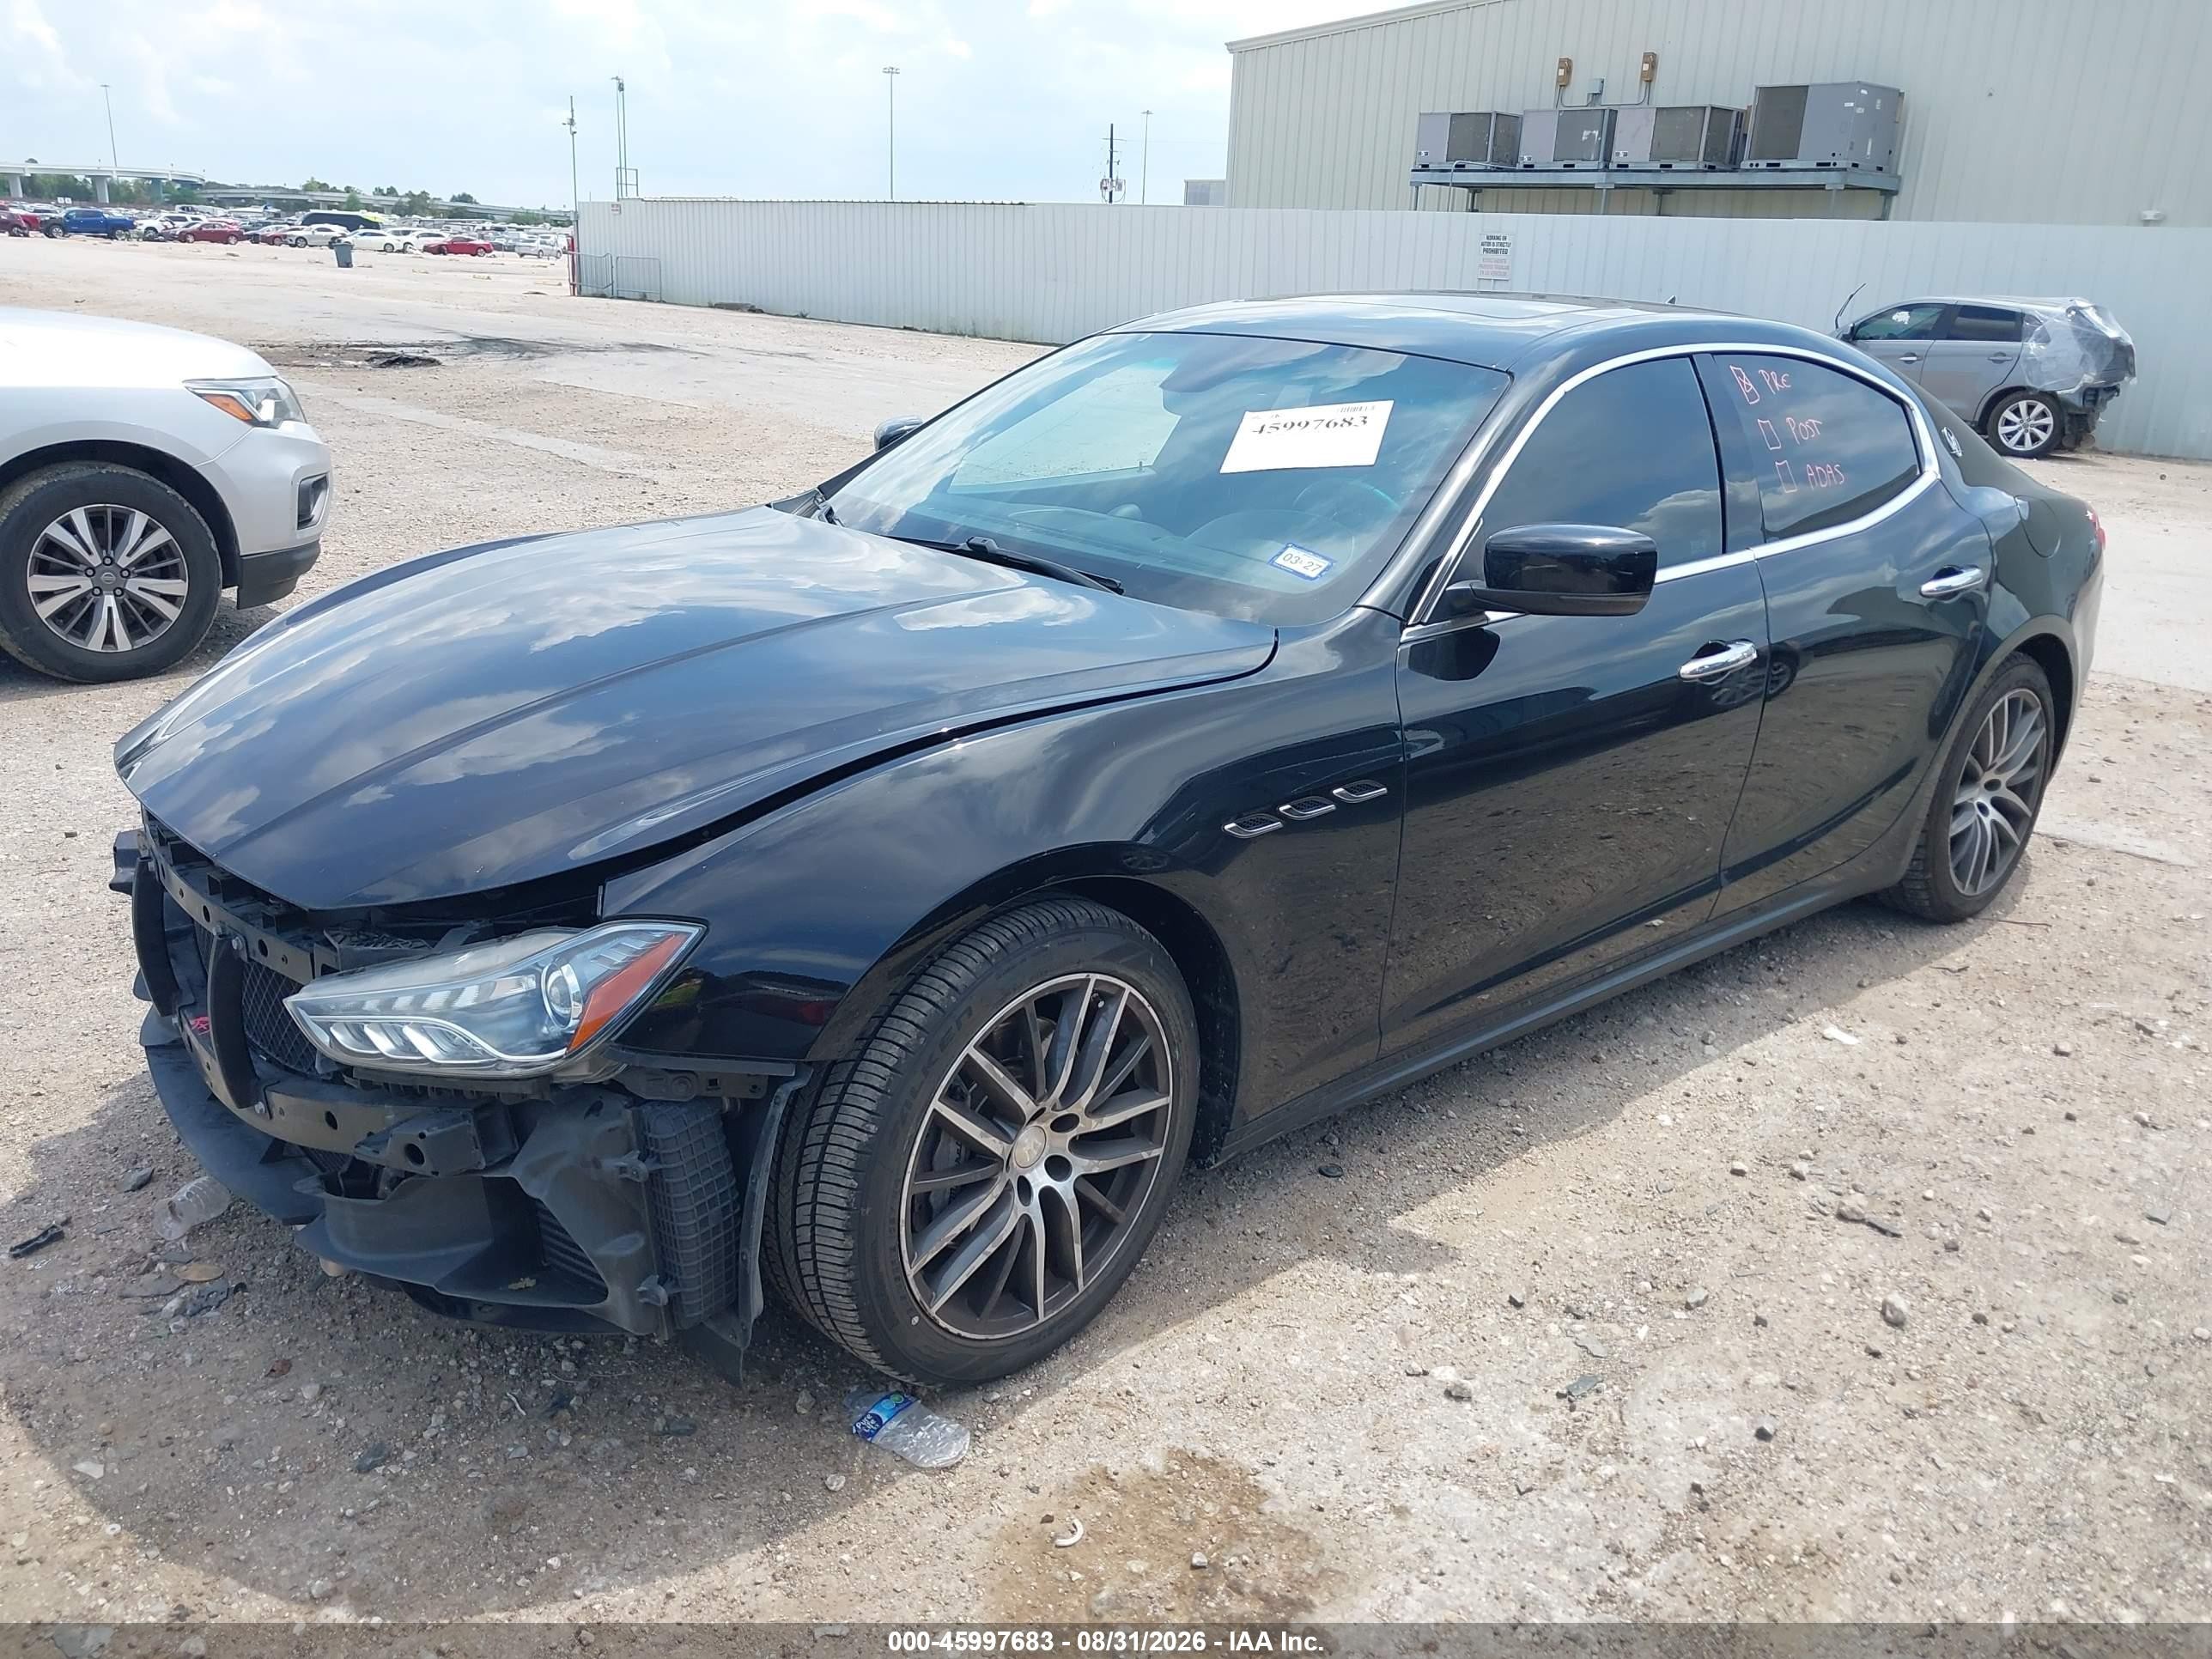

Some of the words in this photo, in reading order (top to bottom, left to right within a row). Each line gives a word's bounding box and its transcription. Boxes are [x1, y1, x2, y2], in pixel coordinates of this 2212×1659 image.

[1759, 369, 1791, 395] PRE
[1251, 416, 1367, 434] 45997683
[1786, 417, 1822, 445] POST
[1807, 464, 1844, 489] ADAS
[855, 1413, 872, 1430] Pure
